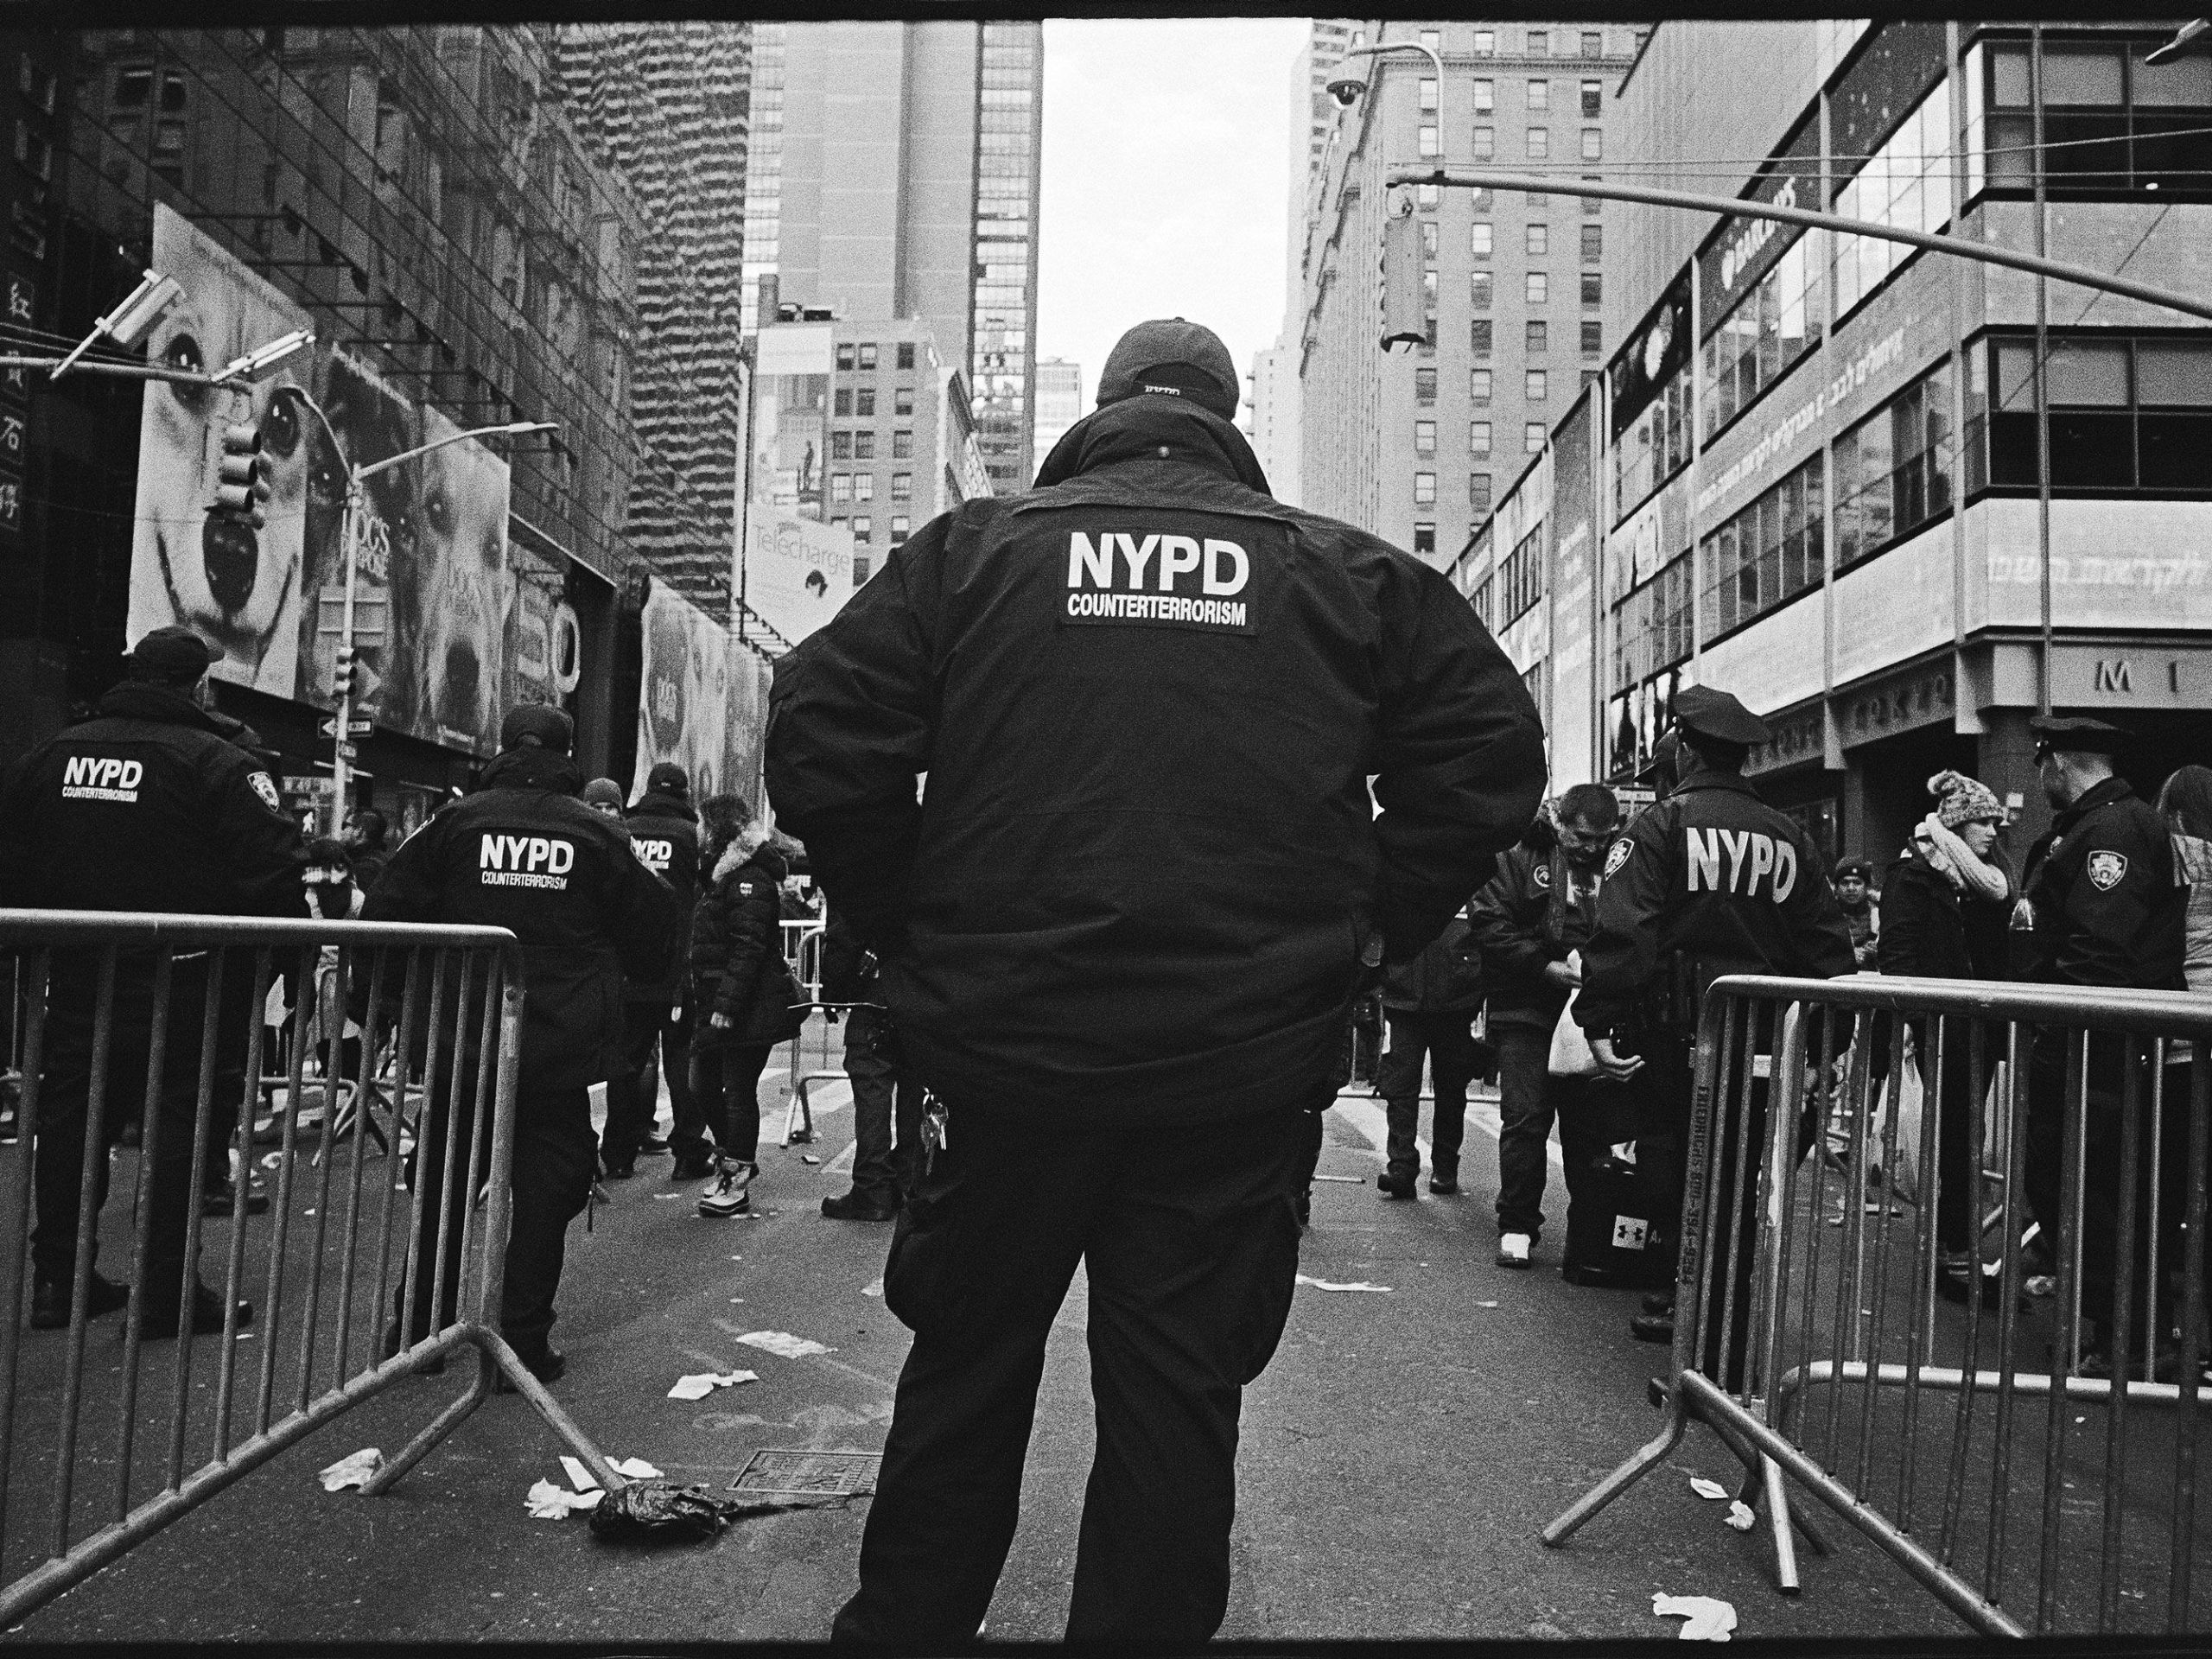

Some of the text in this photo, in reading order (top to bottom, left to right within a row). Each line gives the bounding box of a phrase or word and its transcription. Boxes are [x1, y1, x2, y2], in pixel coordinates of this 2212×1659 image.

[753, 523, 850, 575] Telecharge
[1068, 531, 1249, 596] NYPD
[1067, 593, 1247, 626] COUNTERTERRORISM
[63, 756, 143, 790] NYPD
[62, 785, 138, 803] COUNTERTERRORISM
[480, 834, 575, 874] NYPD
[1686, 827, 1796, 904] NYPD
[481, 870, 571, 891] COUNTERTERRORISM
